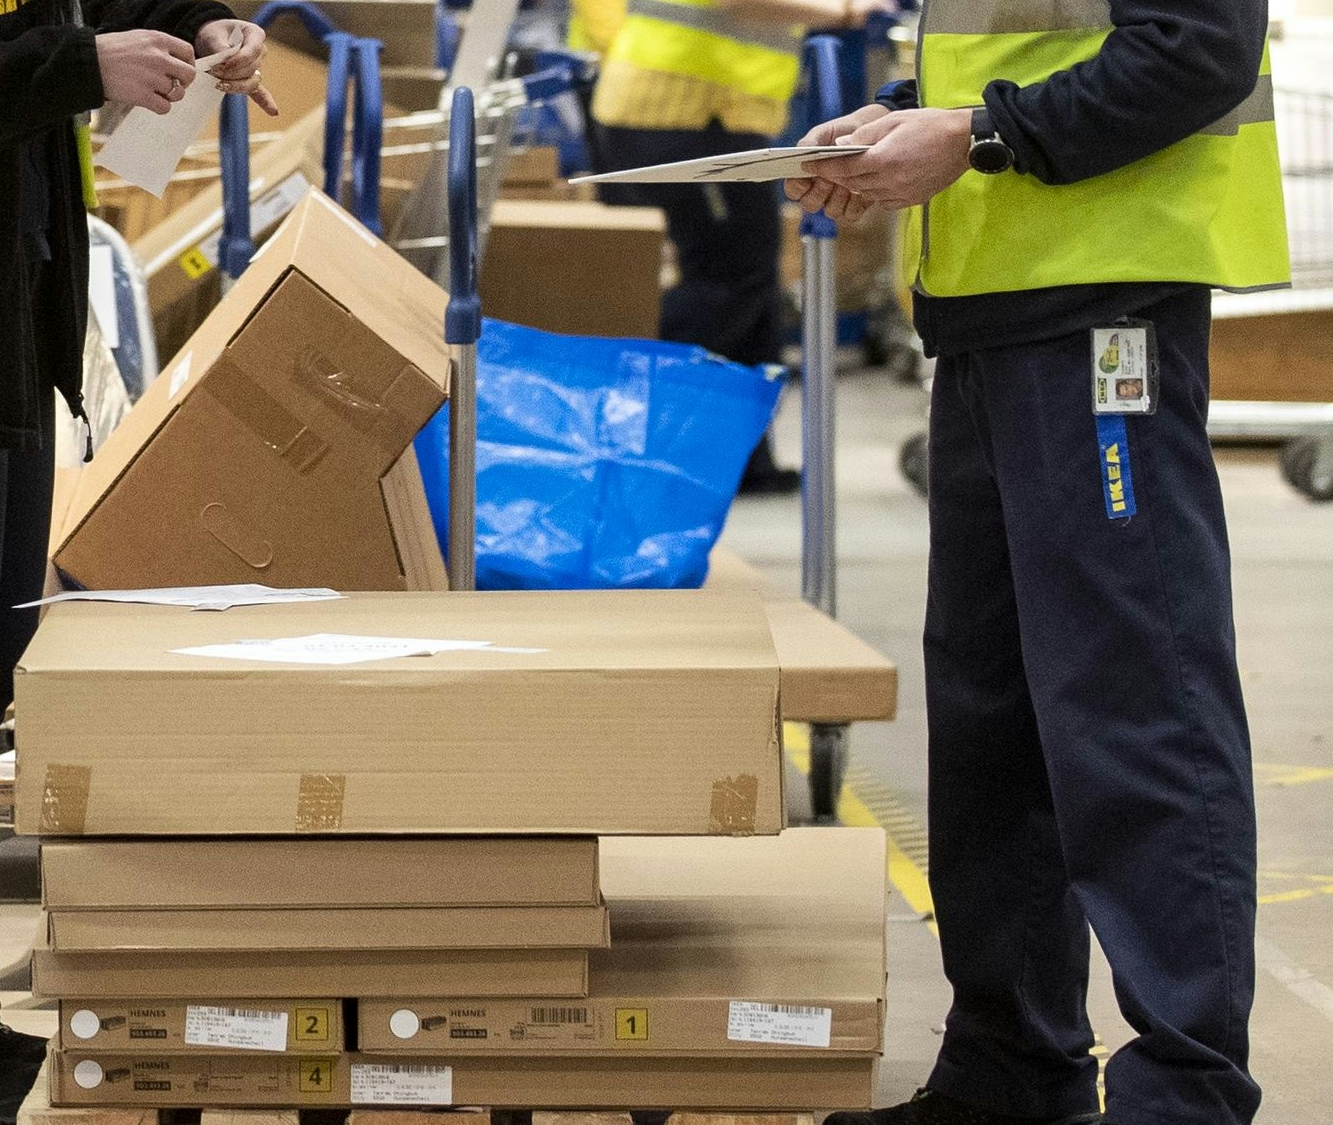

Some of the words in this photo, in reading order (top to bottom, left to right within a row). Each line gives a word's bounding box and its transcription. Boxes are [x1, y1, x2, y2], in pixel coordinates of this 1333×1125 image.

[1105, 443, 1126, 512] IKEA
[131, 1009, 166, 1018] HEMNES
[305, 1015, 318, 1034] 2
[626, 1016, 636, 1034] 1
[134, 1062, 170, 1070] HEMNES
[308, 1067, 321, 1085] 4
